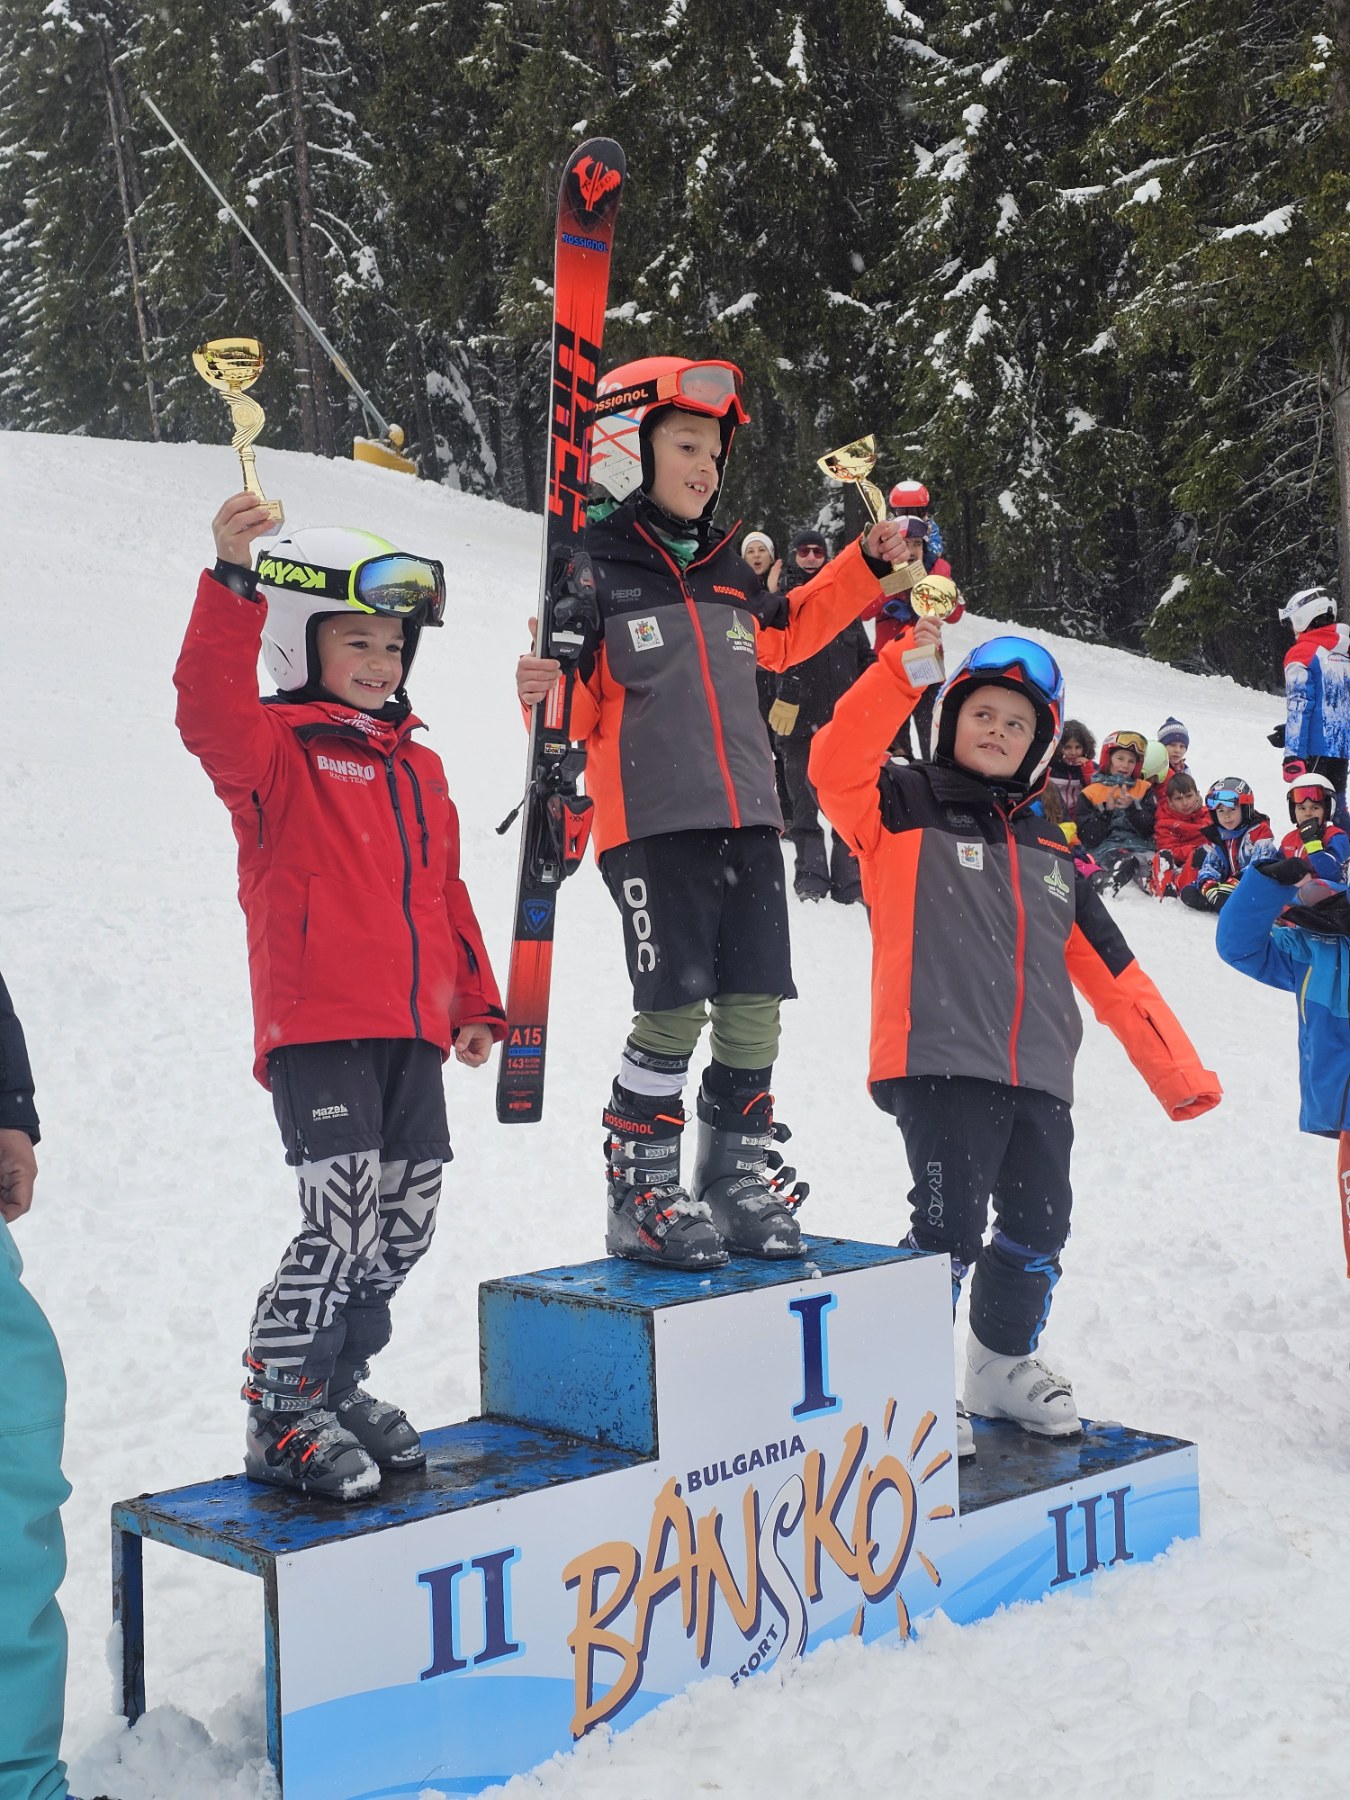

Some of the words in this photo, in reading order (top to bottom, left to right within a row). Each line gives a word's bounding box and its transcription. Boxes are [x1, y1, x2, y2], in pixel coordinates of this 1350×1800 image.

[561, 232, 608, 253] ROSSIGNOL
[611, 588, 642, 600] HERO
[316, 755, 376, 781] BANSKO
[329, 771, 348, 783] RACE
[623, 877, 656, 972] POC
[509, 1027, 542, 1046] A15
[507, 1058, 524, 1069] 143
[604, 1113, 655, 1135] ROSSIGNOL
[788, 1292, 840, 1420] I
[686, 1434, 806, 1492] BULGARIA
[1047, 1485, 1135, 1588] III
[562, 1422, 917, 1741] BANSKO
[417, 1547, 523, 1684] II
[730, 1623, 778, 1689] ESORT
